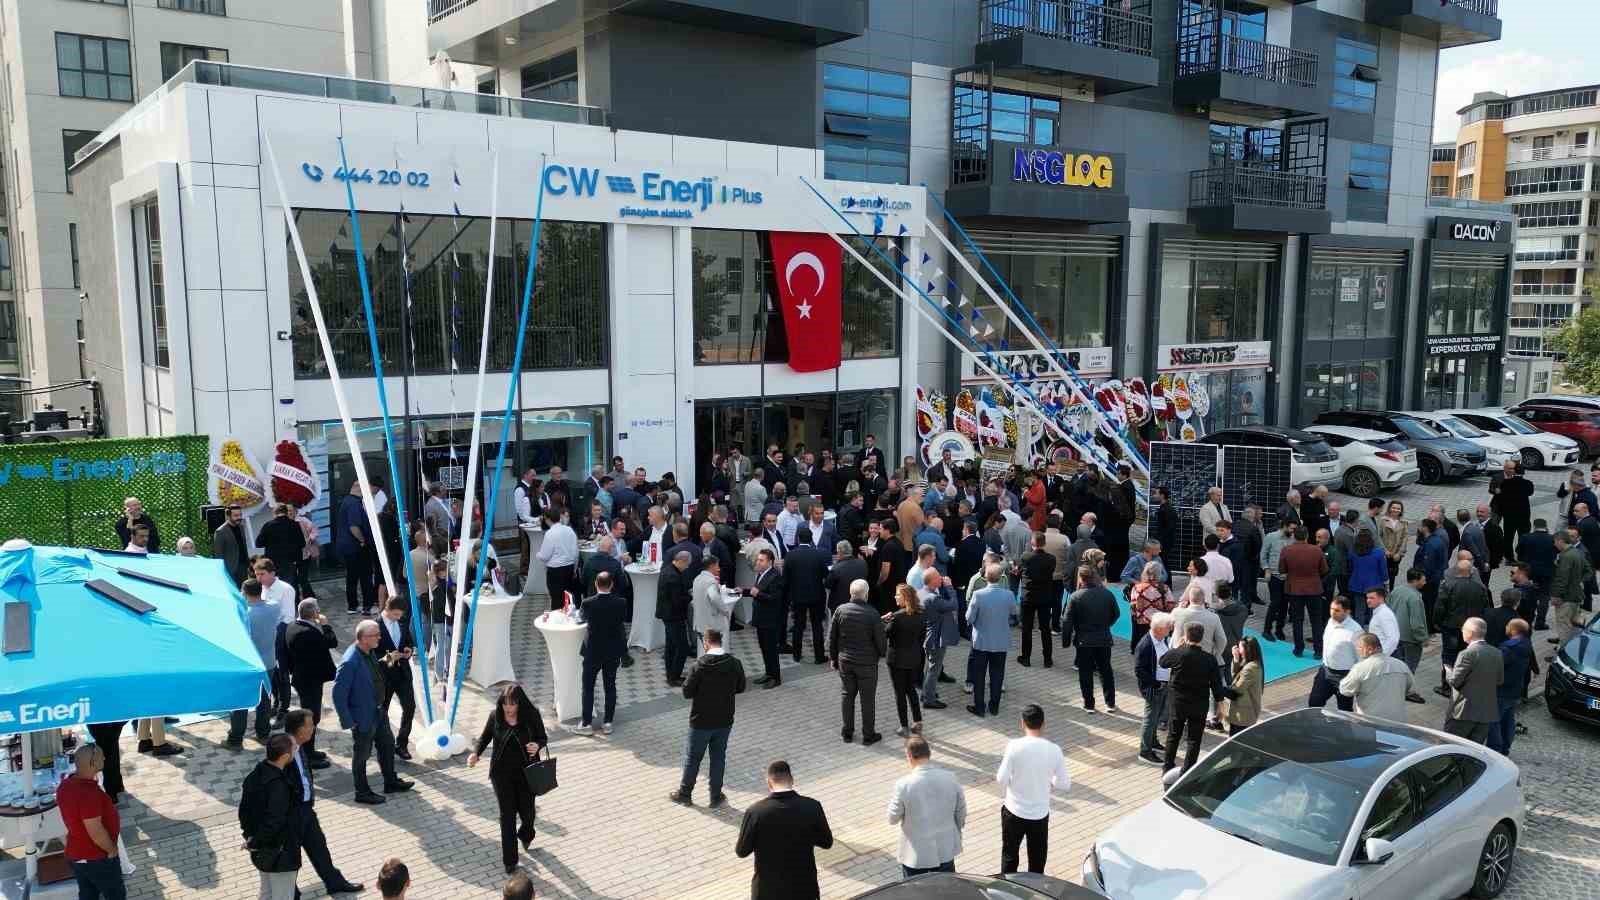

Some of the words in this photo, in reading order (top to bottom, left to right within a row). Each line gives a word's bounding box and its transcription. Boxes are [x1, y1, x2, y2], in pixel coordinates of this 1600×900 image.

[333, 166, 373, 184] 444
[377, 169, 402, 185] 20
[406, 171, 430, 187] 02
[544, 164, 600, 197] CW
[642, 171, 713, 211] Enerji
[732, 187, 763, 204] Plus
[19, 697, 91, 725] Enerji
